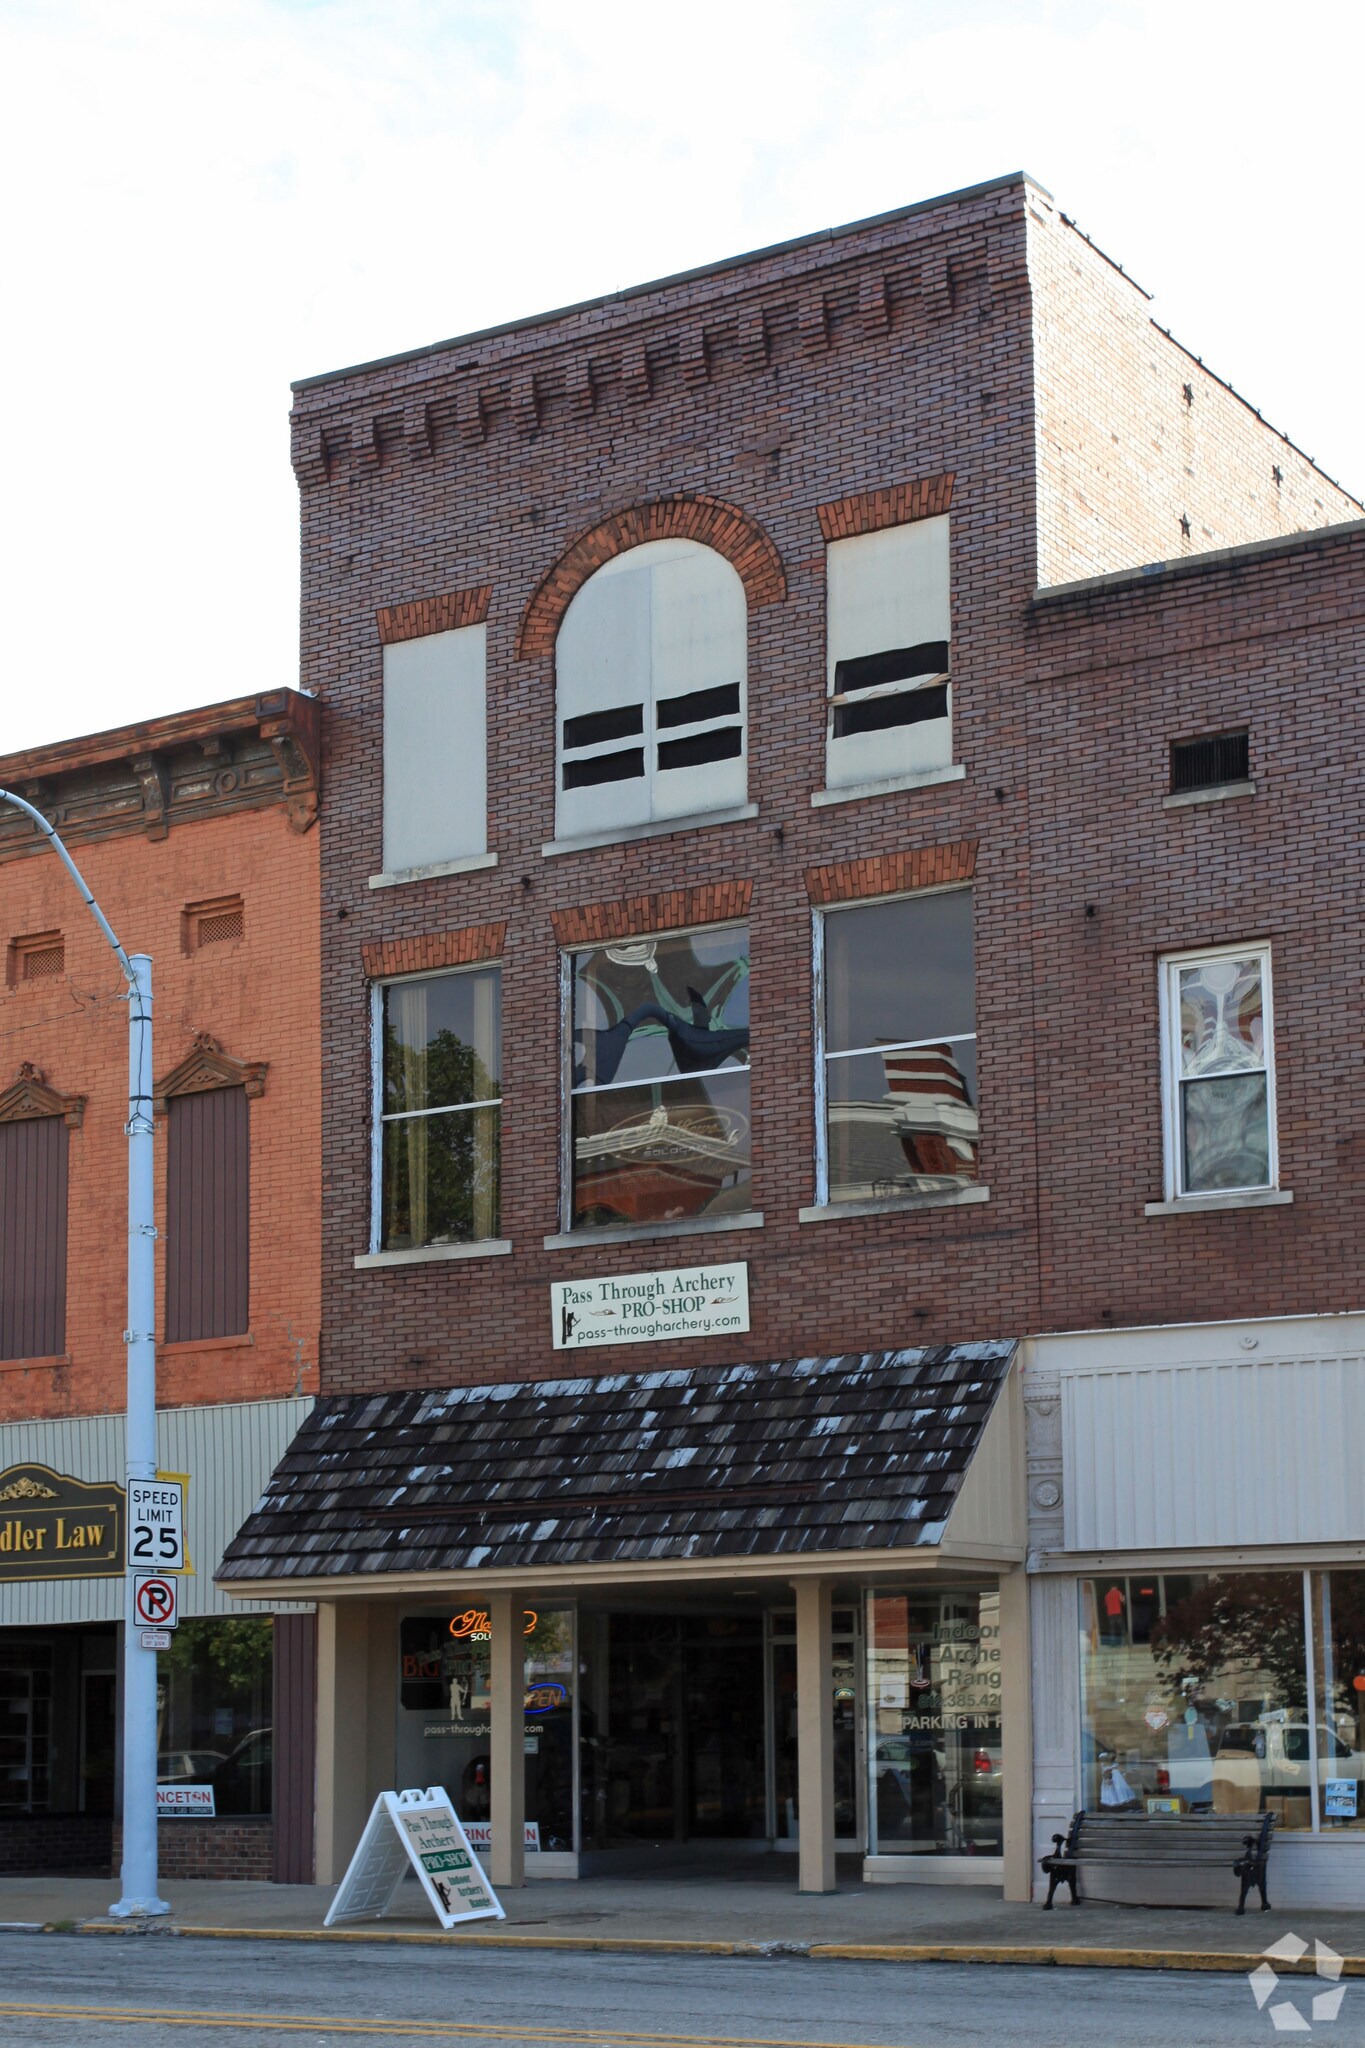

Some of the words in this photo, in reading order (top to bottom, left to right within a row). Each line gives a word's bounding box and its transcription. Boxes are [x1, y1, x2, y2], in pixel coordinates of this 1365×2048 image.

[562, 1287, 592, 1304] Pass
[598, 1277, 665, 1301] Through
[672, 1273, 735, 1294] Archery
[622, 1296, 706, 1319] PRO-SHOP
[578, 1315, 741, 1343] pass-througharchery.com
[133, 1489, 178, 1505] SPEED
[138, 1508, 173, 1522] LIMIT
[56, 1518, 105, 1549] Law
[133, 1526, 178, 1559] 25
[933, 1622, 1000, 1639] Indoor
[940, 1646, 1001, 1662] Arche
[948, 1669, 1001, 1689] Rang
[525, 1690, 561, 1707] PEN
[918, 1693, 1001, 1708] 812.385.42
[902, 1716, 968, 1729] PARKING
[974, 1716, 989, 1729] IN
[418, 1833, 456, 1849] Archery
[422, 1851, 469, 1870] PRO-SHOP
